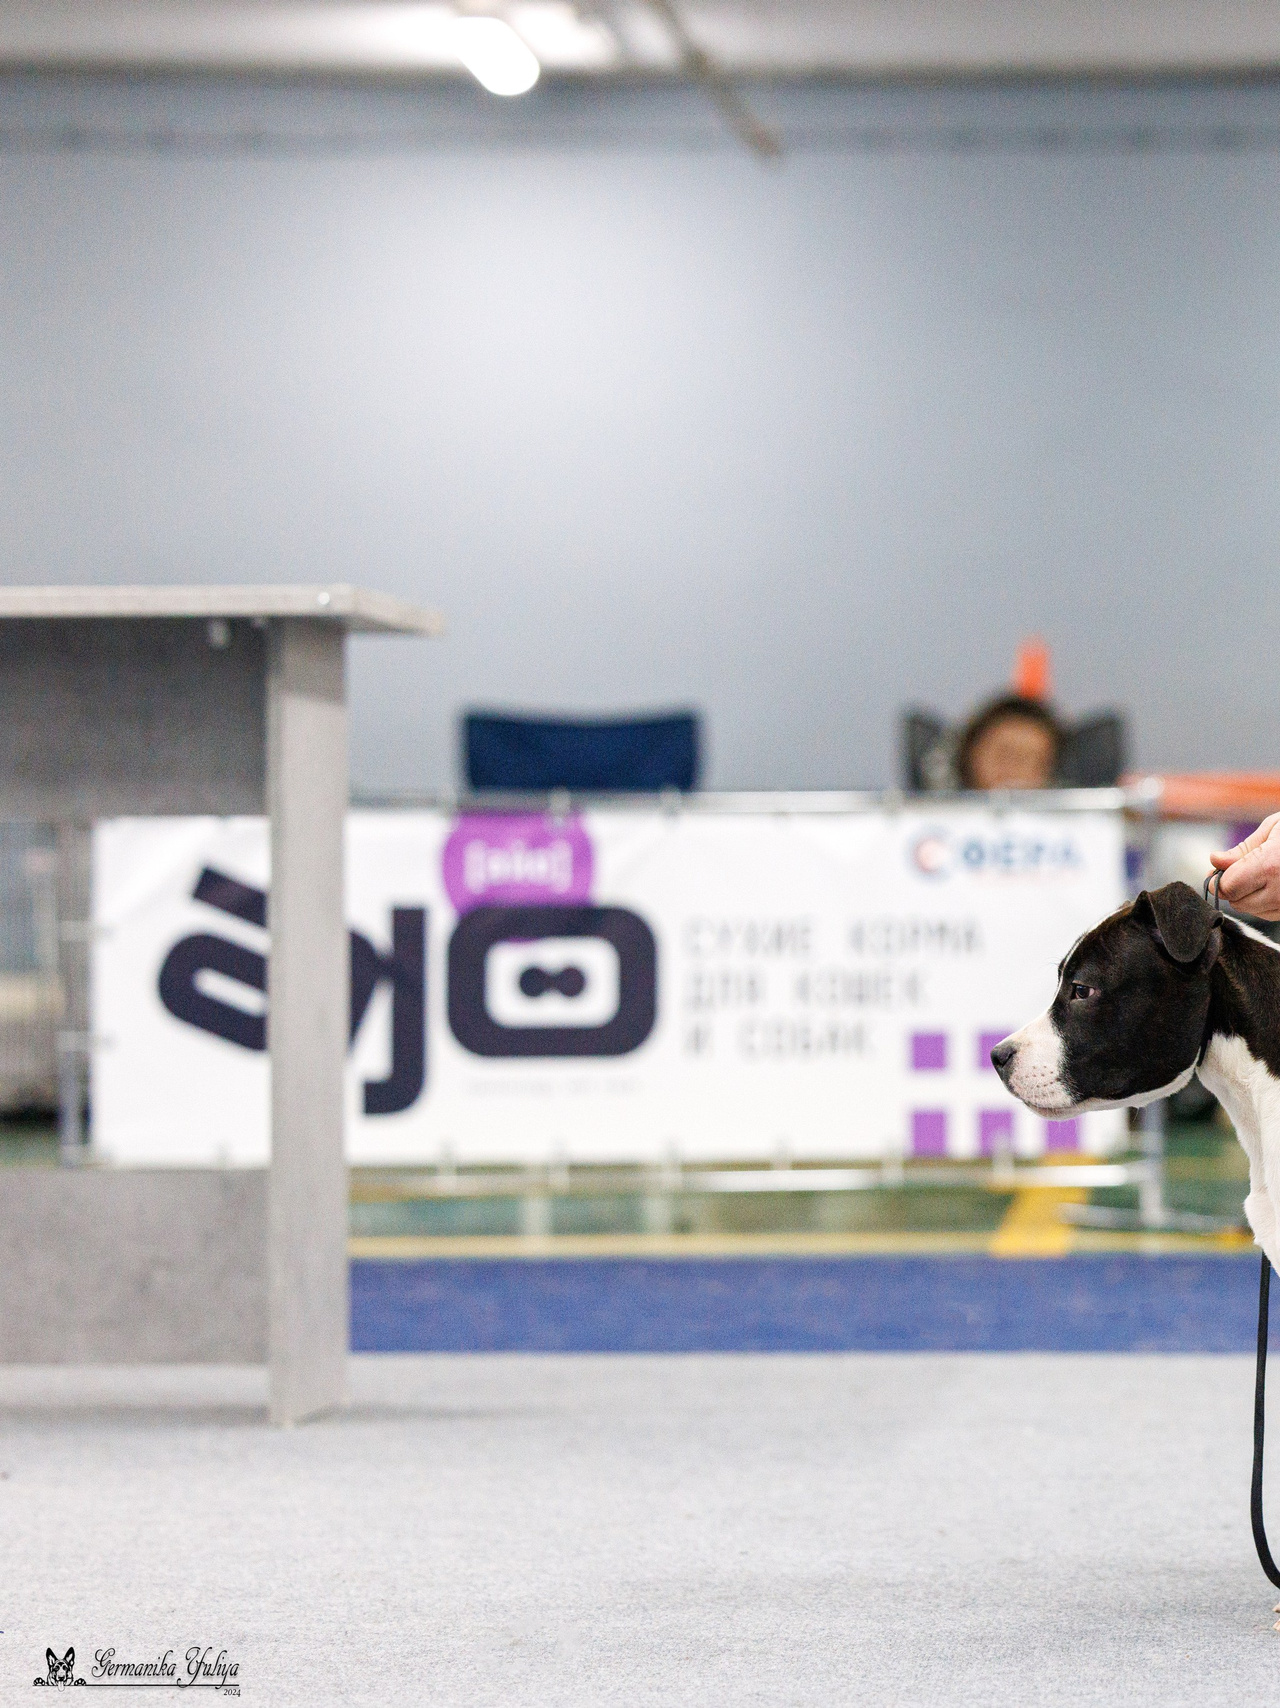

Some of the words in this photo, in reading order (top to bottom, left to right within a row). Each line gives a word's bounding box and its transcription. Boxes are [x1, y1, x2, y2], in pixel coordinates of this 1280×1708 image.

[685, 916, 812, 956] СУХИЕ
[848, 916, 983, 956] КОРМА
[685, 967, 764, 1010] ДЛЯ
[795, 967, 928, 1008] КОШЕК
[685, 1018, 709, 1058] И
[738, 1018, 872, 1058] СОБАК
